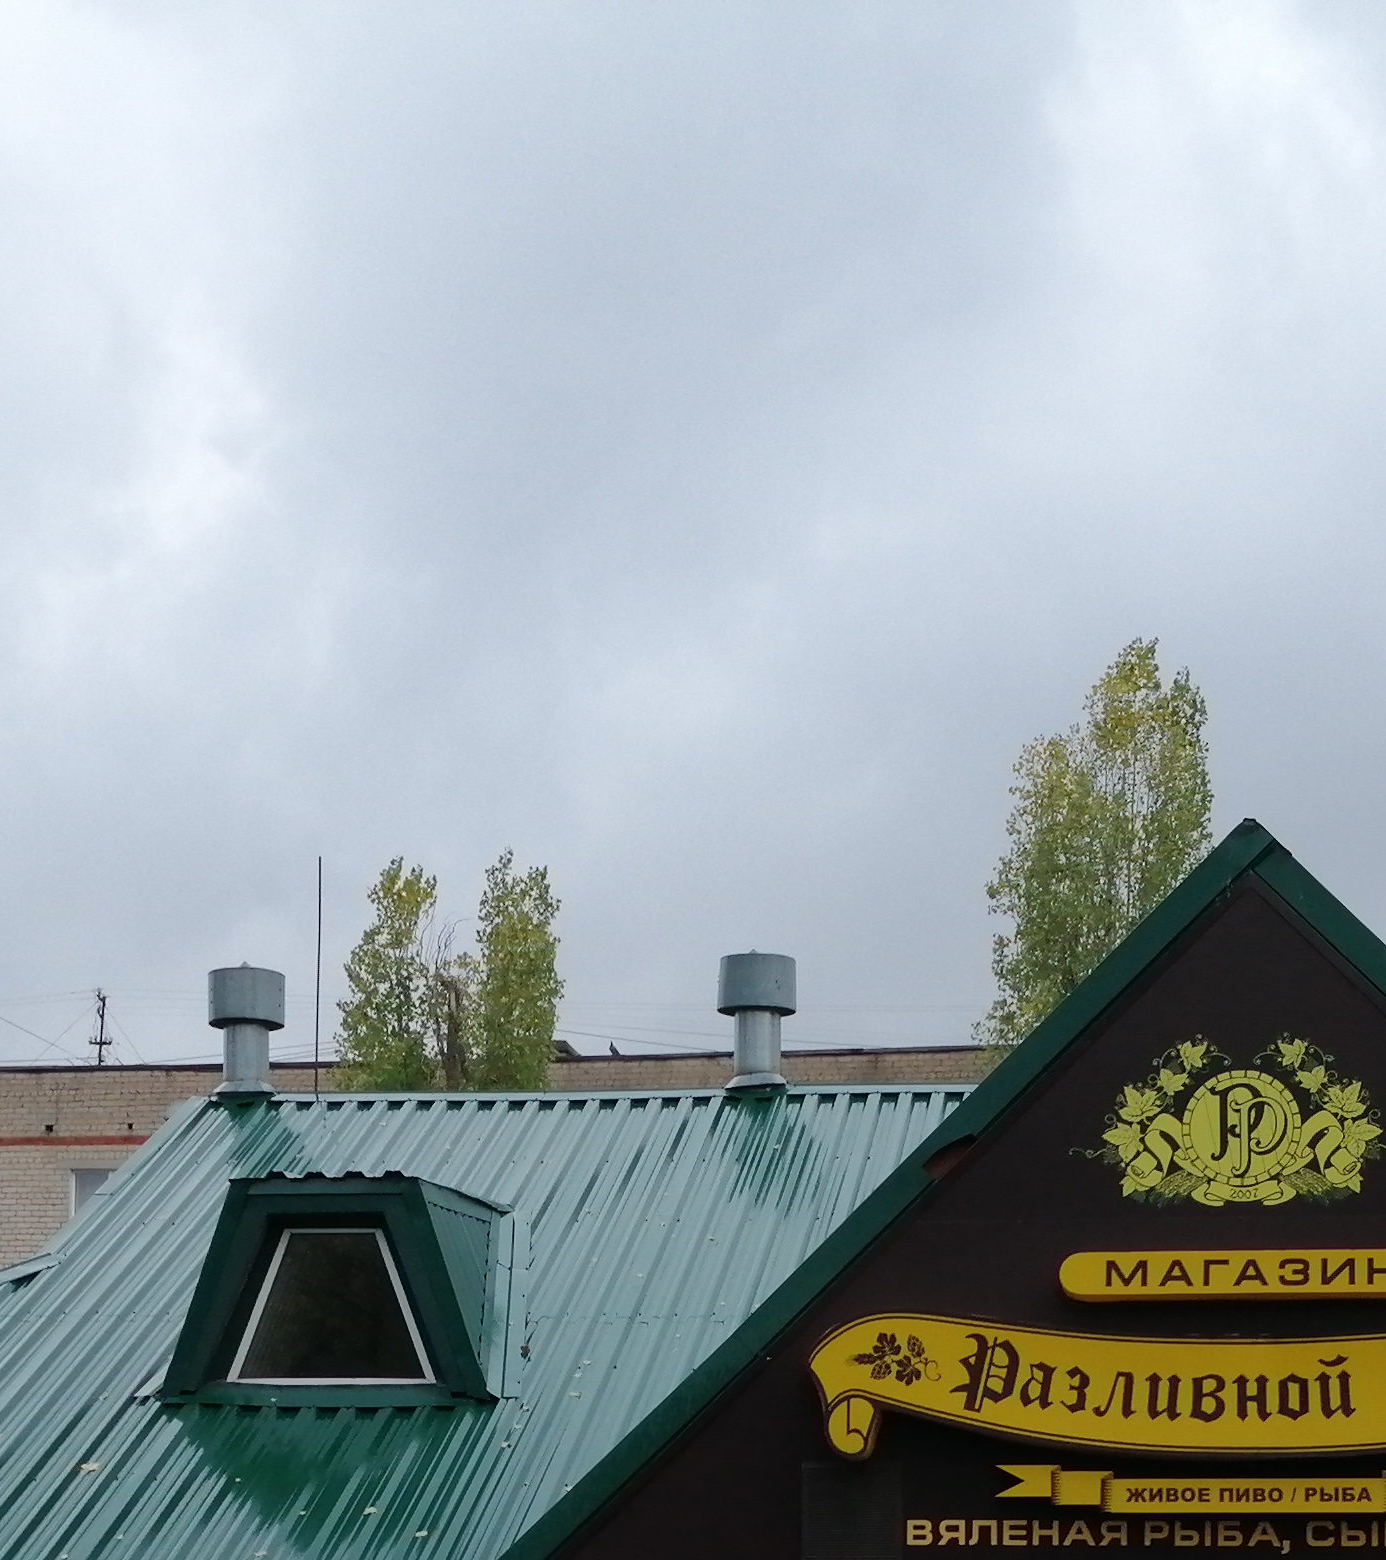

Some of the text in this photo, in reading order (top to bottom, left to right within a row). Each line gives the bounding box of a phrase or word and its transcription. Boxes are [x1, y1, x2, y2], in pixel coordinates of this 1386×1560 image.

[1229, 1187, 1259, 1200] 2007
[950, 1333, 1356, 1422] Разливной
[1125, 1486, 1212, 1504] ЖИВОЕ
[1218, 1486, 1284, 1503] ПИВО
[1303, 1485, 1373, 1503] РЫБА
[905, 1521, 1131, 1548] ВЯЛЕНАЯ
[1143, 1521, 1292, 1555] РЫБА,
